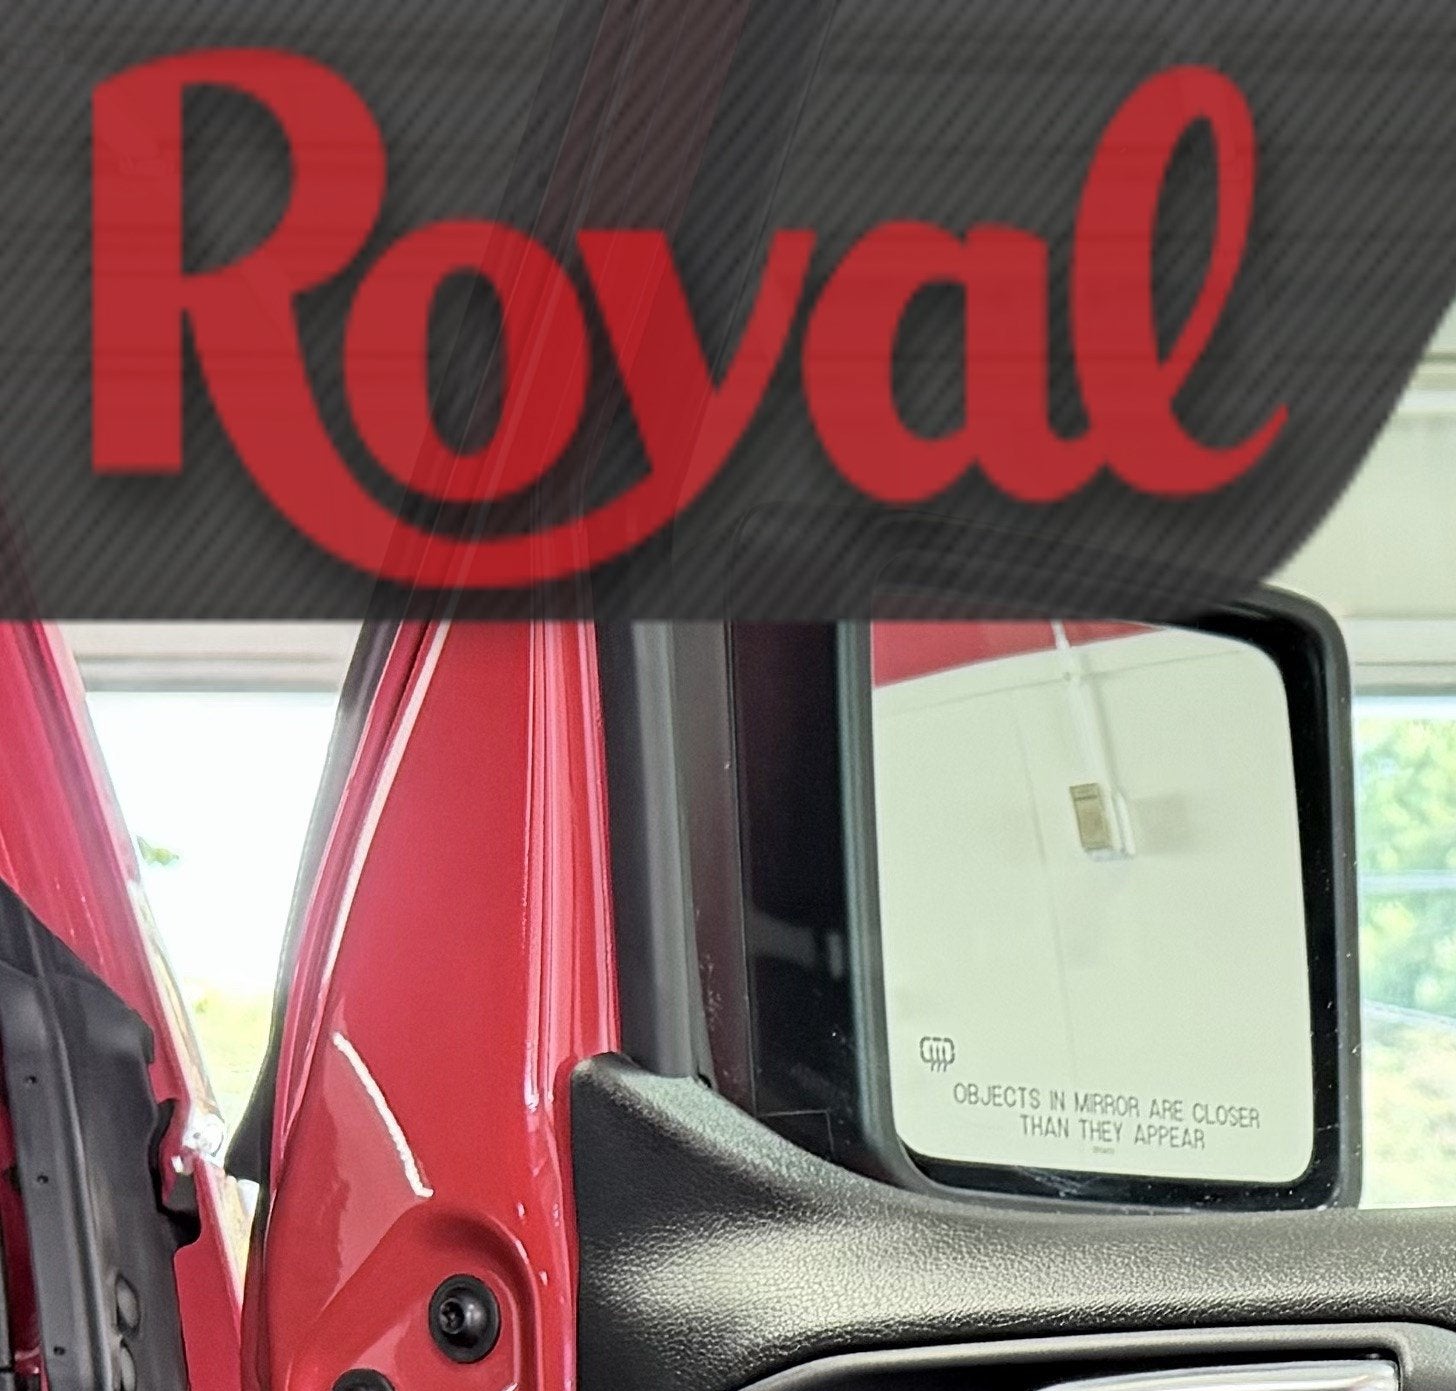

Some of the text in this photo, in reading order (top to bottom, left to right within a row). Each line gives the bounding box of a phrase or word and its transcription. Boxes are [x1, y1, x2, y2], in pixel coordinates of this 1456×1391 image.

[953, 1082, 1261, 1129] OBJECTS IN MIRROR ARE CLOSER
[1019, 1113, 1206, 1150] THAN THEY APPEAR
